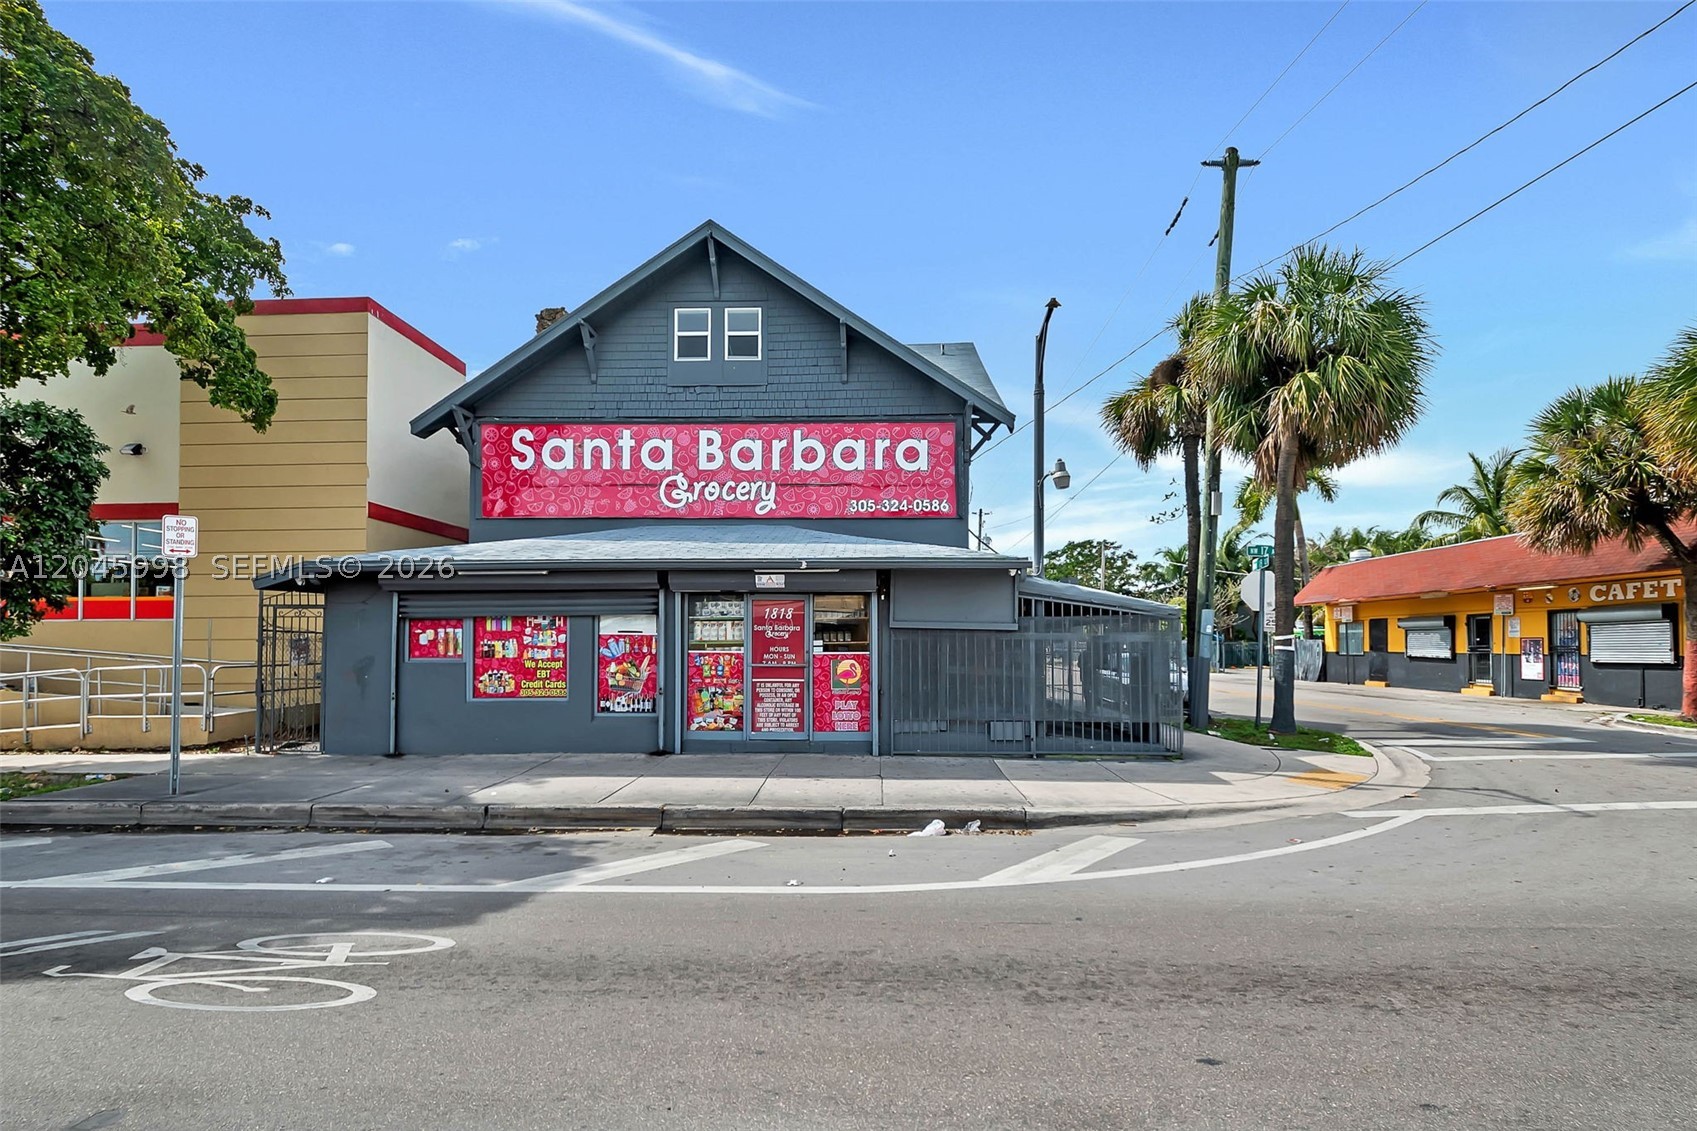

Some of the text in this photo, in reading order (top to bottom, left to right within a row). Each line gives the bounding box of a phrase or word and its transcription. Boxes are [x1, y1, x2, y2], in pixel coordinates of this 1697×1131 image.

[510, 428, 930, 471] Santa Barbara
[660, 472, 777, 515] Grocery
[850, 500, 949, 512] 305-324-0586
[1261, 546, 1269, 555] 17
[1589, 578, 1682, 602] CAFET
[764, 608, 794, 619] 1818
[538, 660, 563, 669] Accept
[536, 670, 550, 678] EBT
[521, 680, 566, 689] Credit Cards
[835, 700, 858, 710] PLAY
[832, 710, 861, 720] LOTTO
[835, 722, 858, 731] HERE
